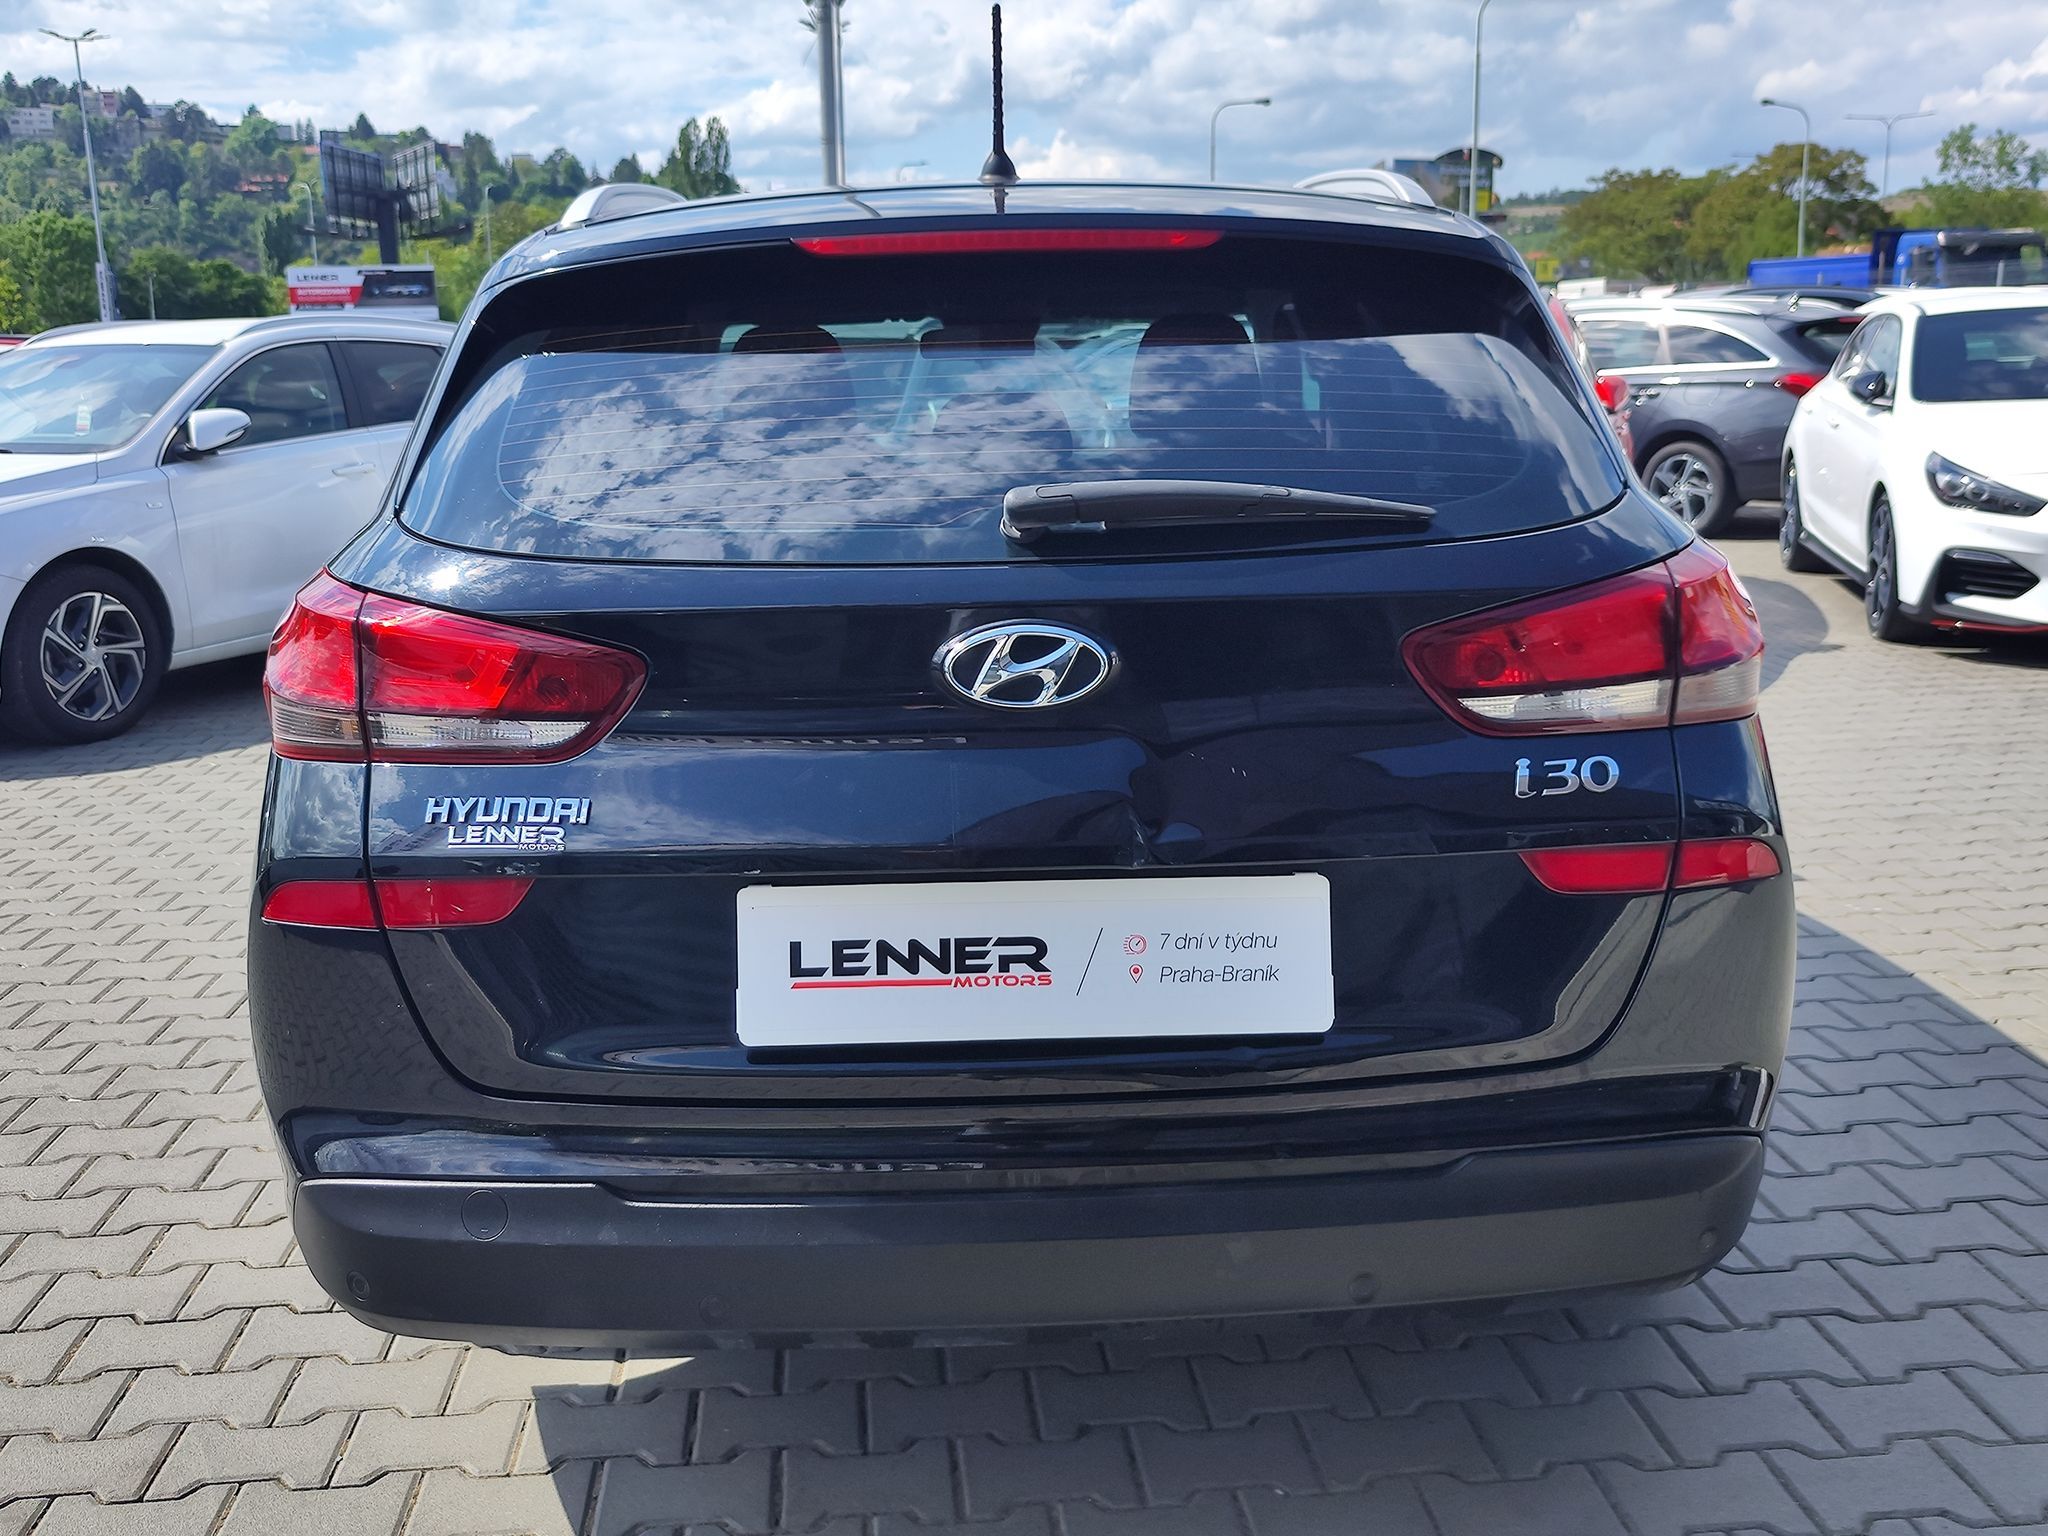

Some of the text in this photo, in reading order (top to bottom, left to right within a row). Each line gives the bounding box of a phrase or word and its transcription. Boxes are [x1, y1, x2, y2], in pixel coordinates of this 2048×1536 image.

[1514, 755, 1620, 799] i30
[424, 796, 592, 824] HYUNDAI
[448, 825, 566, 844] LENNER
[518, 843, 566, 852] MOTORS
[1160, 931, 1278, 953] 7 dní v týdnu
[789, 936, 1052, 979] LENNER
[953, 974, 1053, 988] MOTORS
[1159, 964, 1280, 983] Praha-Braník
